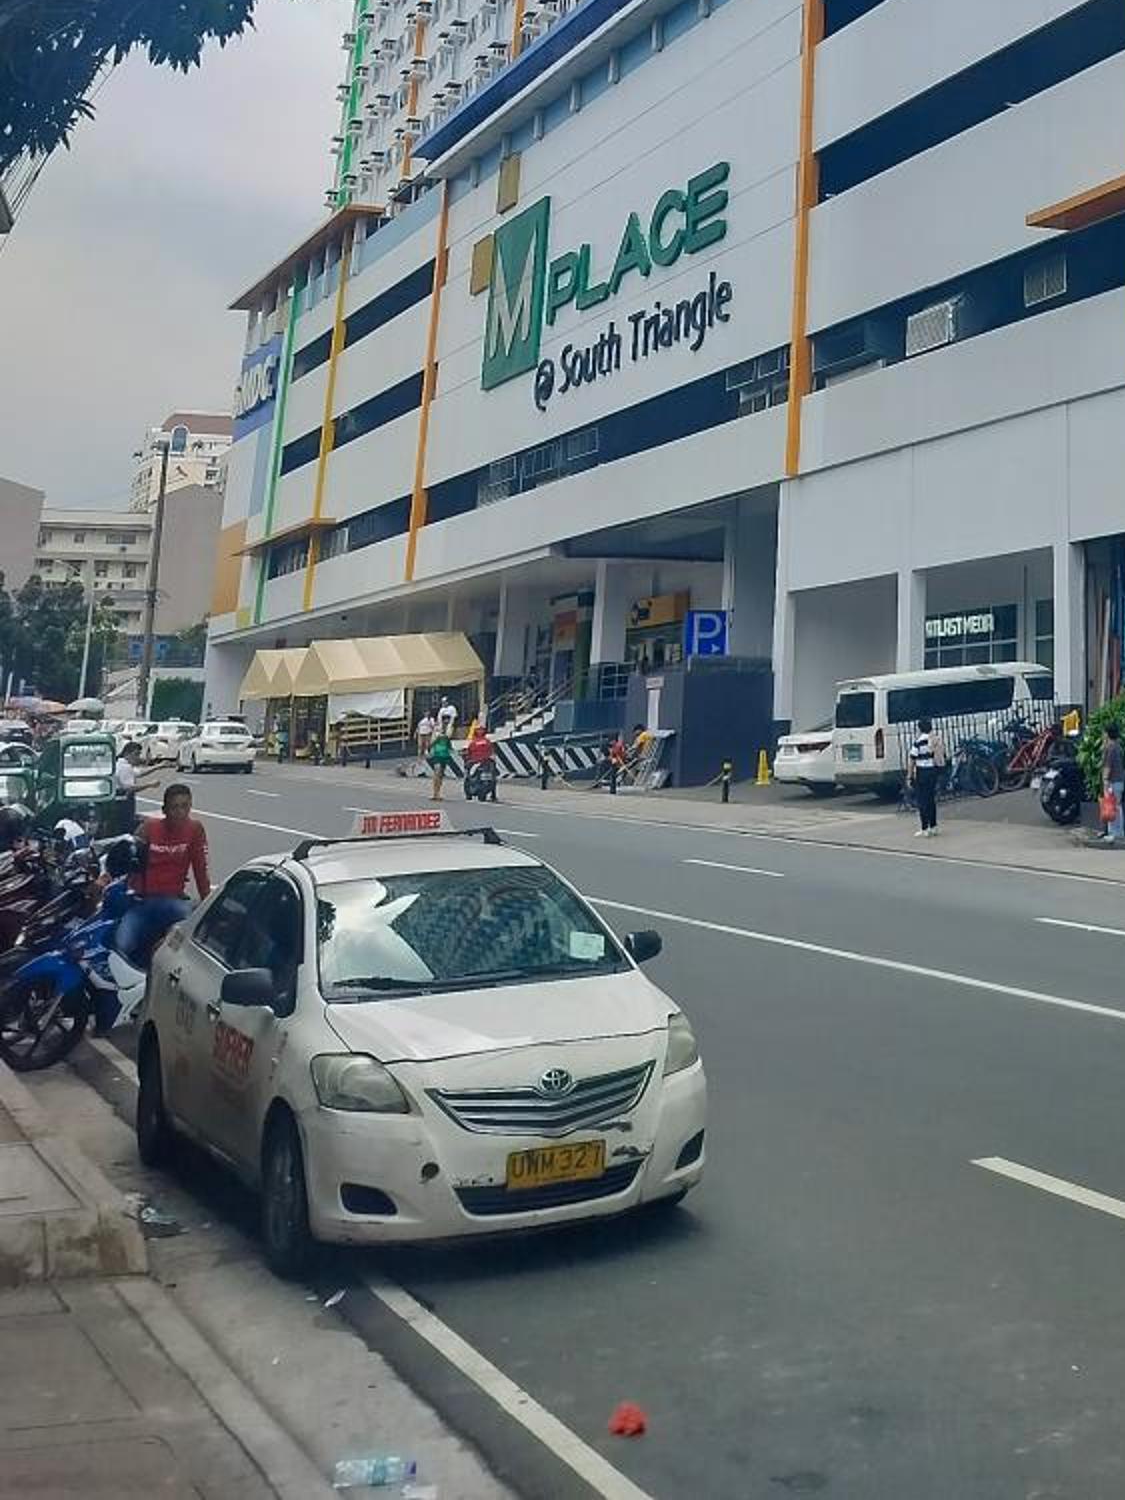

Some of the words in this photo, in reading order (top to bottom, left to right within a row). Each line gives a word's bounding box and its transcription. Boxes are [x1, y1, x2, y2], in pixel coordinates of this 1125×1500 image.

[545, 161, 731, 326] PLACE
[533, 358, 555, 412] @
[559, 322, 621, 394] South
[628, 272, 732, 361] Triangle
[693, 613, 721, 654] P
[380, 813, 441, 833] FERNANDEZ
